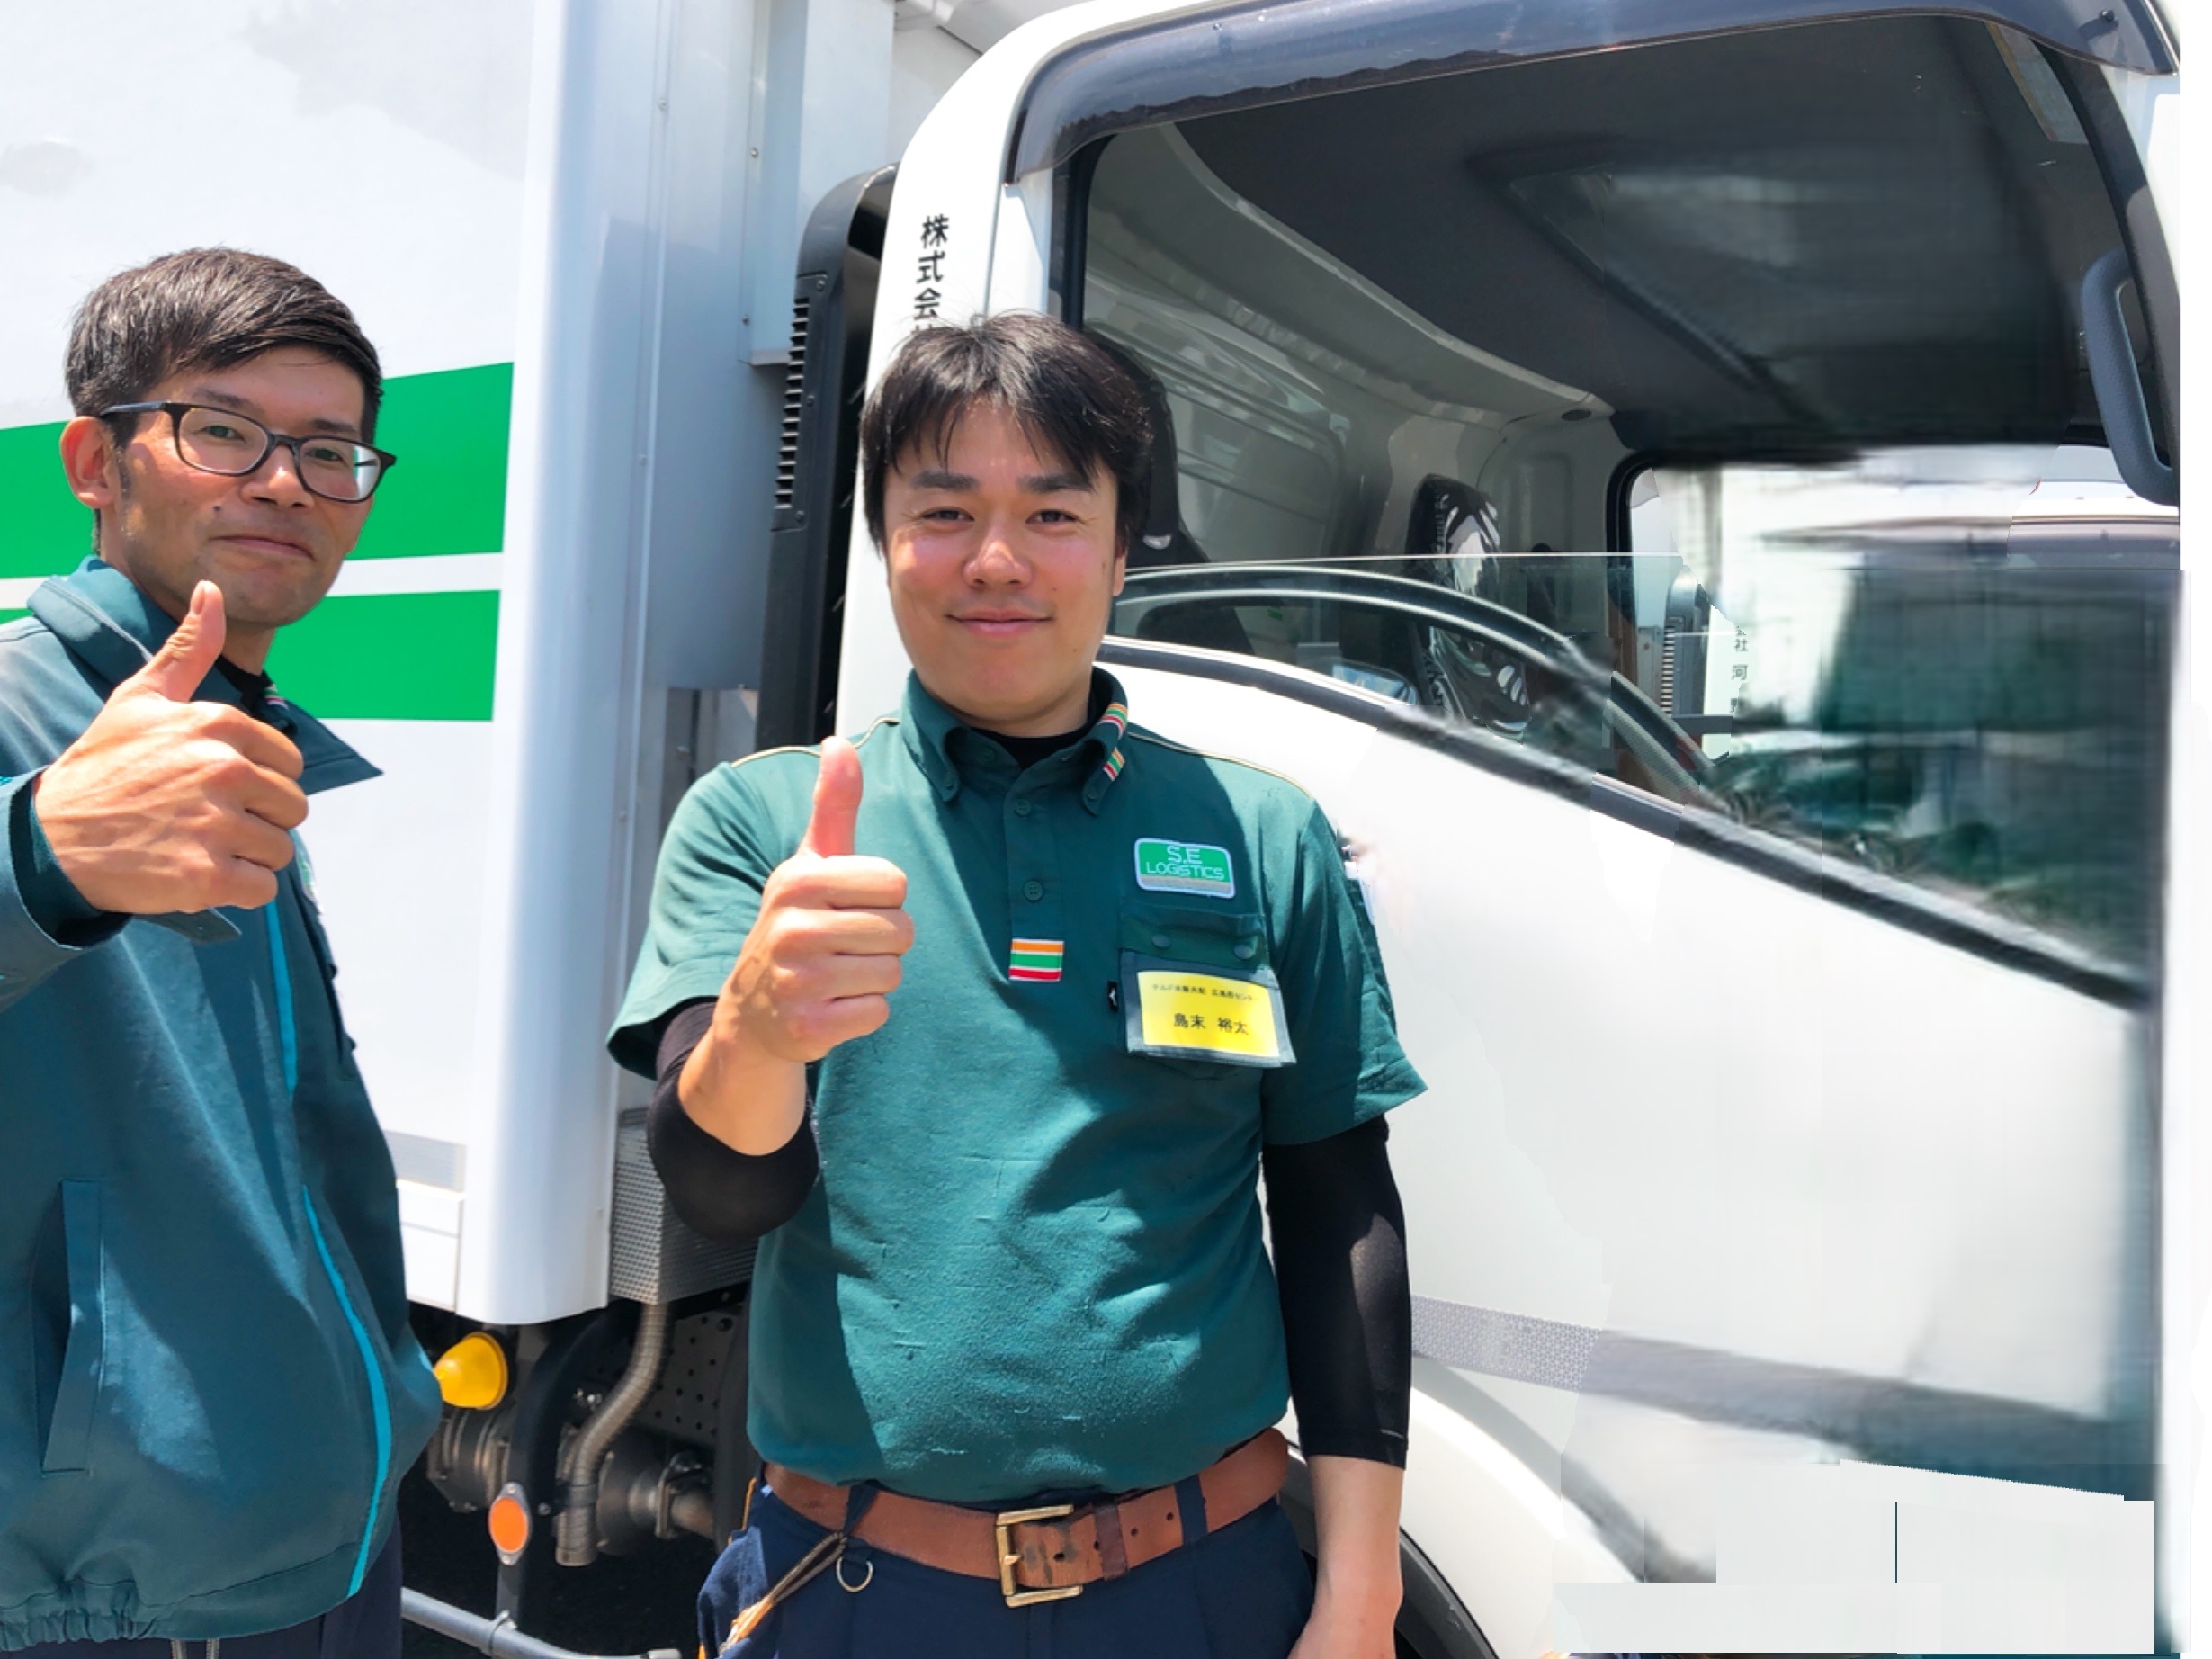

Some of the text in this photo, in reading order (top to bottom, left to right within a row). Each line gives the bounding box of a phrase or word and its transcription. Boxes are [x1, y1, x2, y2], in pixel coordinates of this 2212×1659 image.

[910, 213, 950, 332] 株式会
[1166, 845, 1204, 865] S.E
[1145, 861, 1225, 881] LOGISTICS
